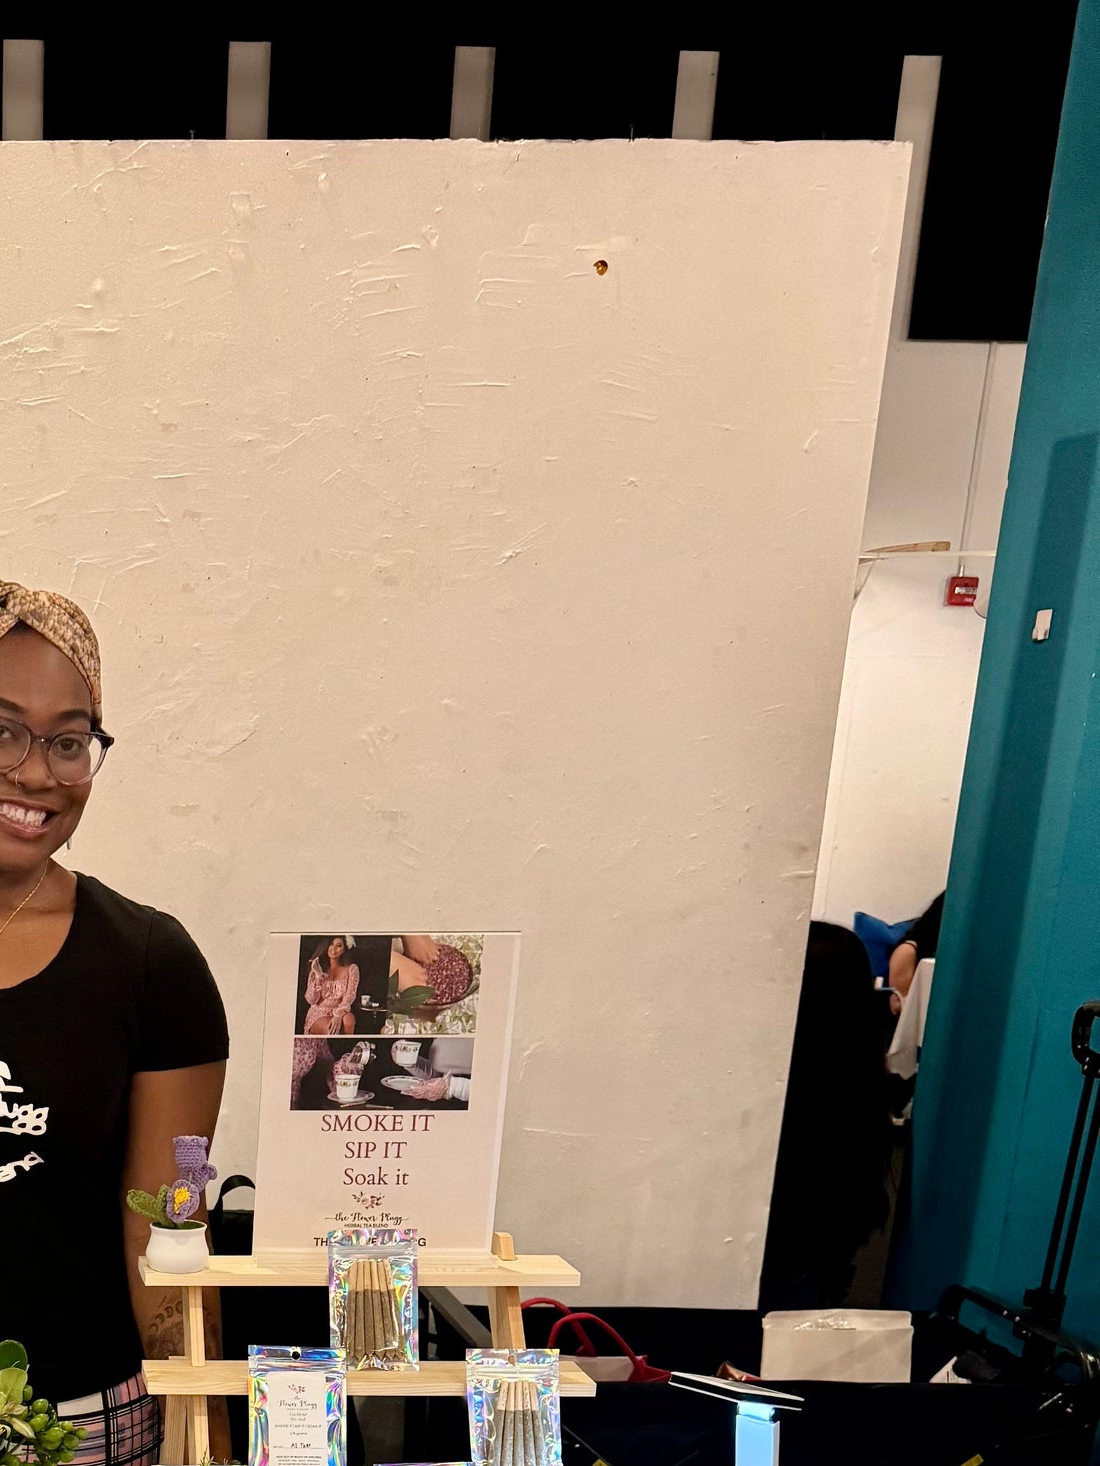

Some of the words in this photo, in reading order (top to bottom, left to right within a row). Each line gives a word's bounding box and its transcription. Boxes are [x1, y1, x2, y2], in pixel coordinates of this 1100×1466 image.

[321, 1114, 404, 1132] SMOKE
[410, 1114, 435, 1132] IT
[344, 1141, 377, 1159] SIP
[383, 1141, 408, 1159] IT
[343, 1166, 389, 1186] Soak
[395, 1168, 410, 1186] it
[379, 1212, 409, 1226] Plugg
